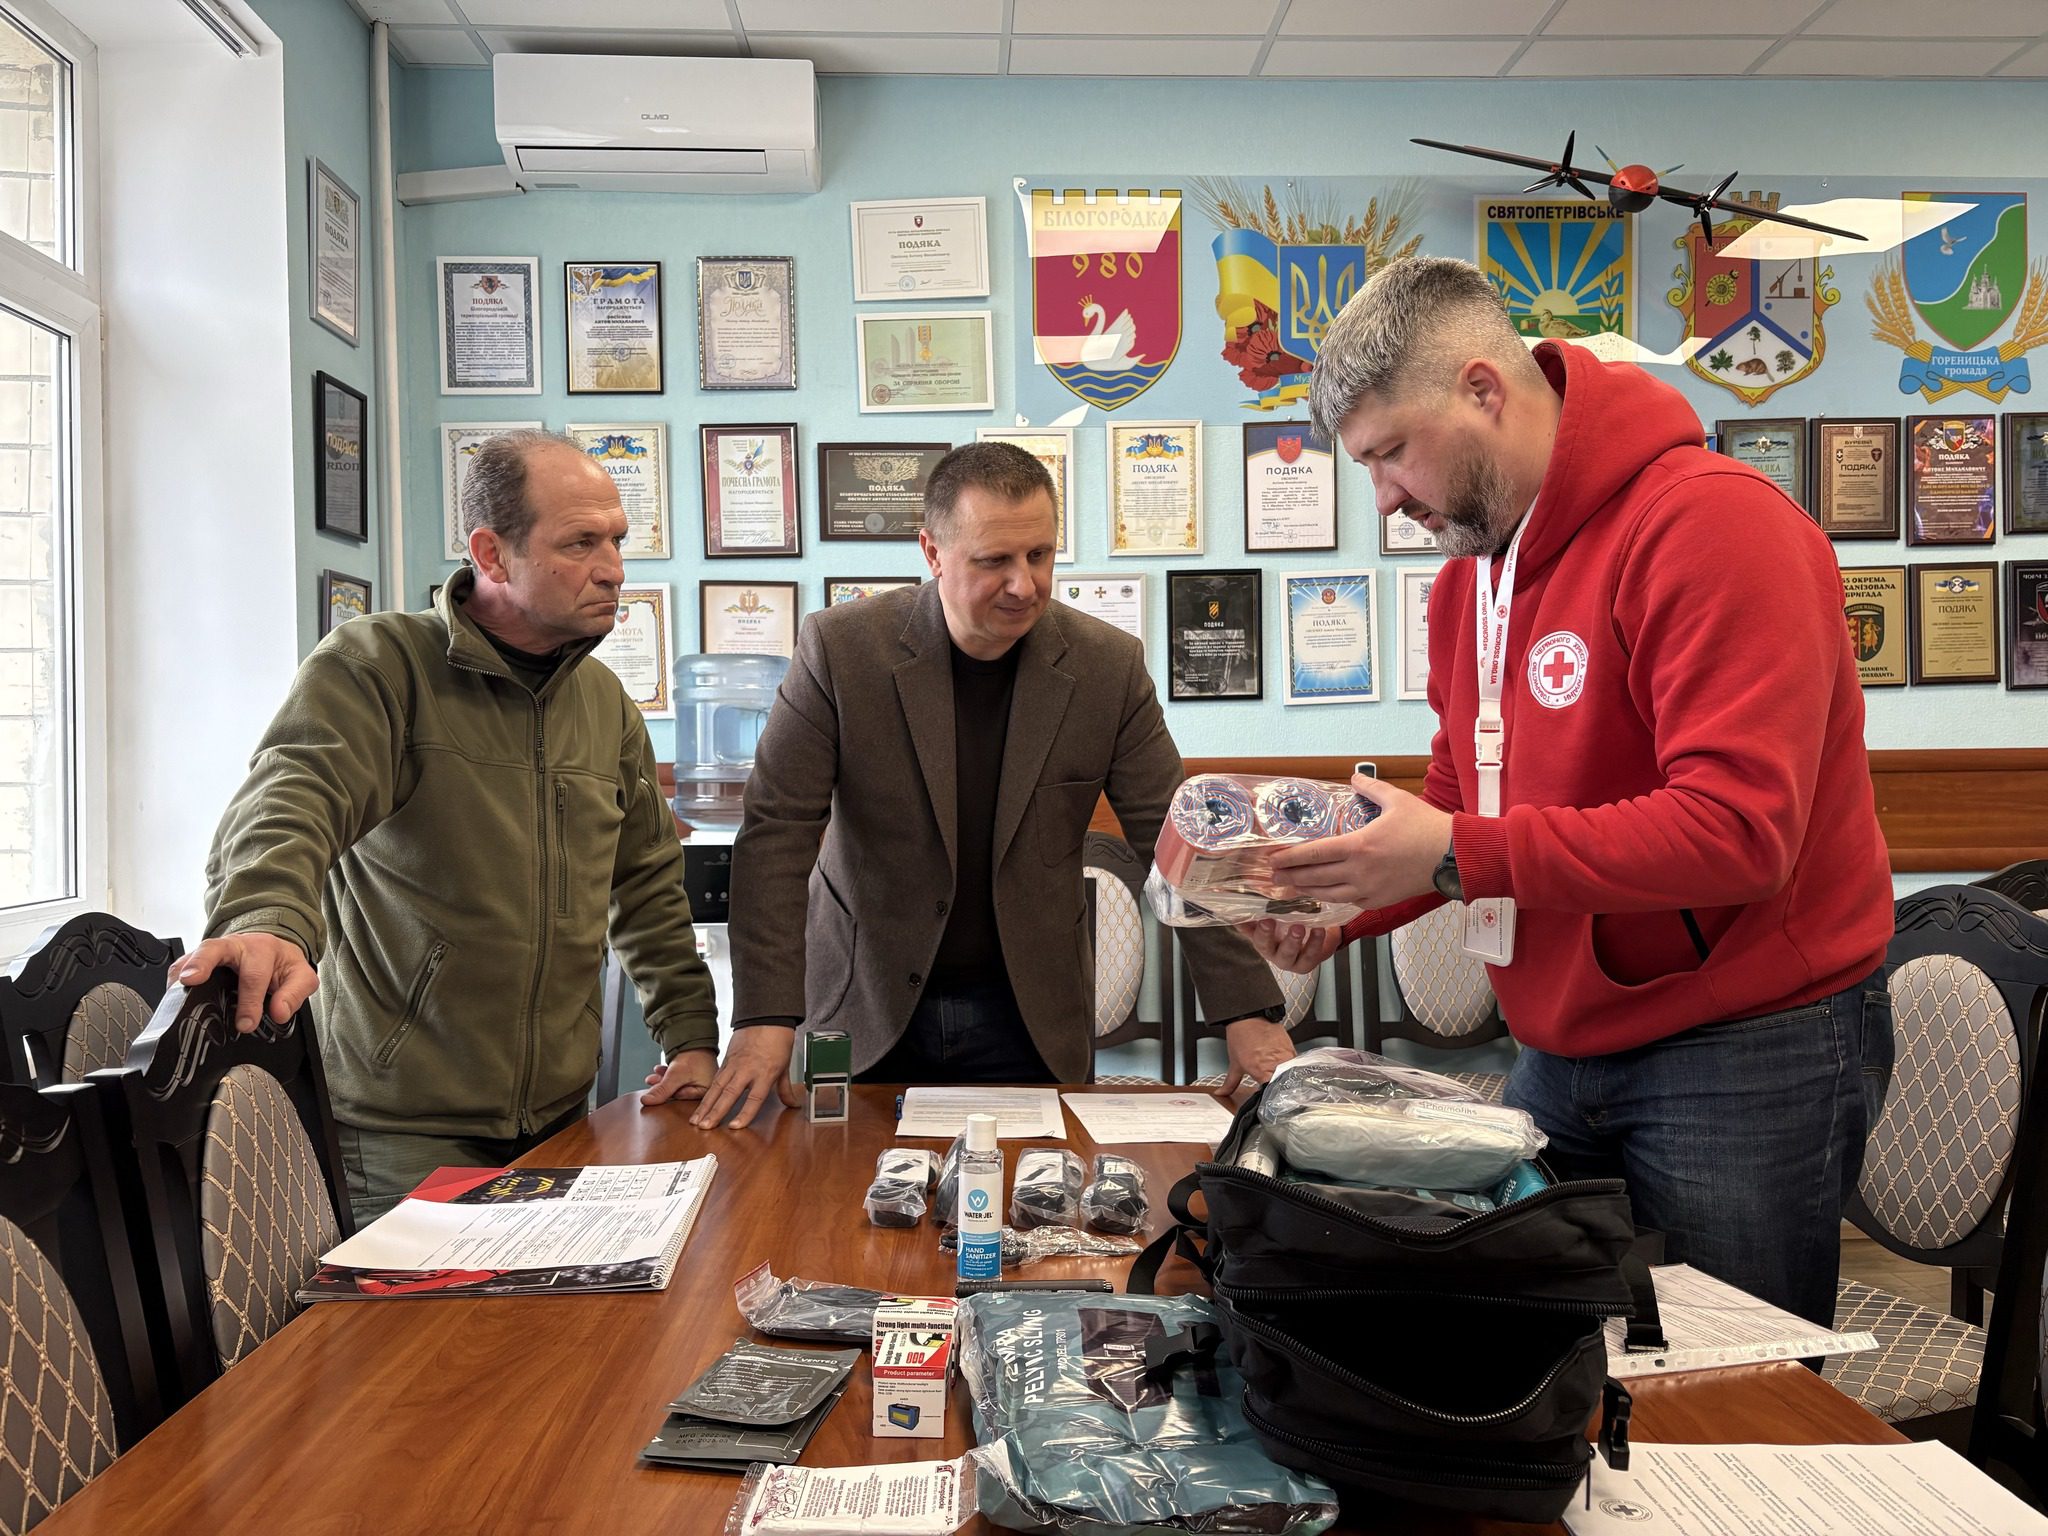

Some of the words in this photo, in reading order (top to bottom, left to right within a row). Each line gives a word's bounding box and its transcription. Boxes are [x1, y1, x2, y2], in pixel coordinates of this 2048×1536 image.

[1487, 205, 1625, 219] СВЯТОПЕТРІВСЬКЕ
[324, 222, 349, 249] ПОДЯКА
[899, 240, 941, 249] ПОДЯКА
[1072, 251, 1144, 279] 980
[1931, 356, 2000, 367] ГОРЕНИЦЬКА
[1944, 367, 1987, 377] громада
[1293, 374, 1311, 384] Муз
[325, 432, 358, 459] ПОДЯКА
[603, 466, 641, 475] ОДЯКА
[1132, 464, 1177, 473] ПОДЯКА
[1266, 467, 1313, 475] ПОДЯКА
[1840, 463, 1877, 471] ПОДЯКА
[722, 476, 752, 487] ПОЧЕСНА
[752, 476, 781, 487] ГРАМОТА
[1844, 583, 1896, 591] ХАНІЗОВАНА
[1938, 605, 1977, 613] ПОДЯКА
[1312, 619, 1347, 627] ПОДЯКА
[610, 627, 643, 636] АМОТА
[1534, 636, 1571, 657] ЧЕРВОНОГО
[1573, 642, 1586, 669] ХРЕСТА
[1532, 662, 1551, 703] ТОВАРИСТВО
[1563, 675, 1583, 702] УКРАЇНИ
[965, 1252, 997, 1260] SANITIZER
[876, 1320, 896, 1330] Strong
[896, 1321, 910, 1330] light
[911, 1321, 953, 1331] multi-function
[1022, 1308, 1044, 1348] SLING
[801, 1357, 838, 1365] VENTED
[1023, 1348, 1045, 1404] PELVIC
